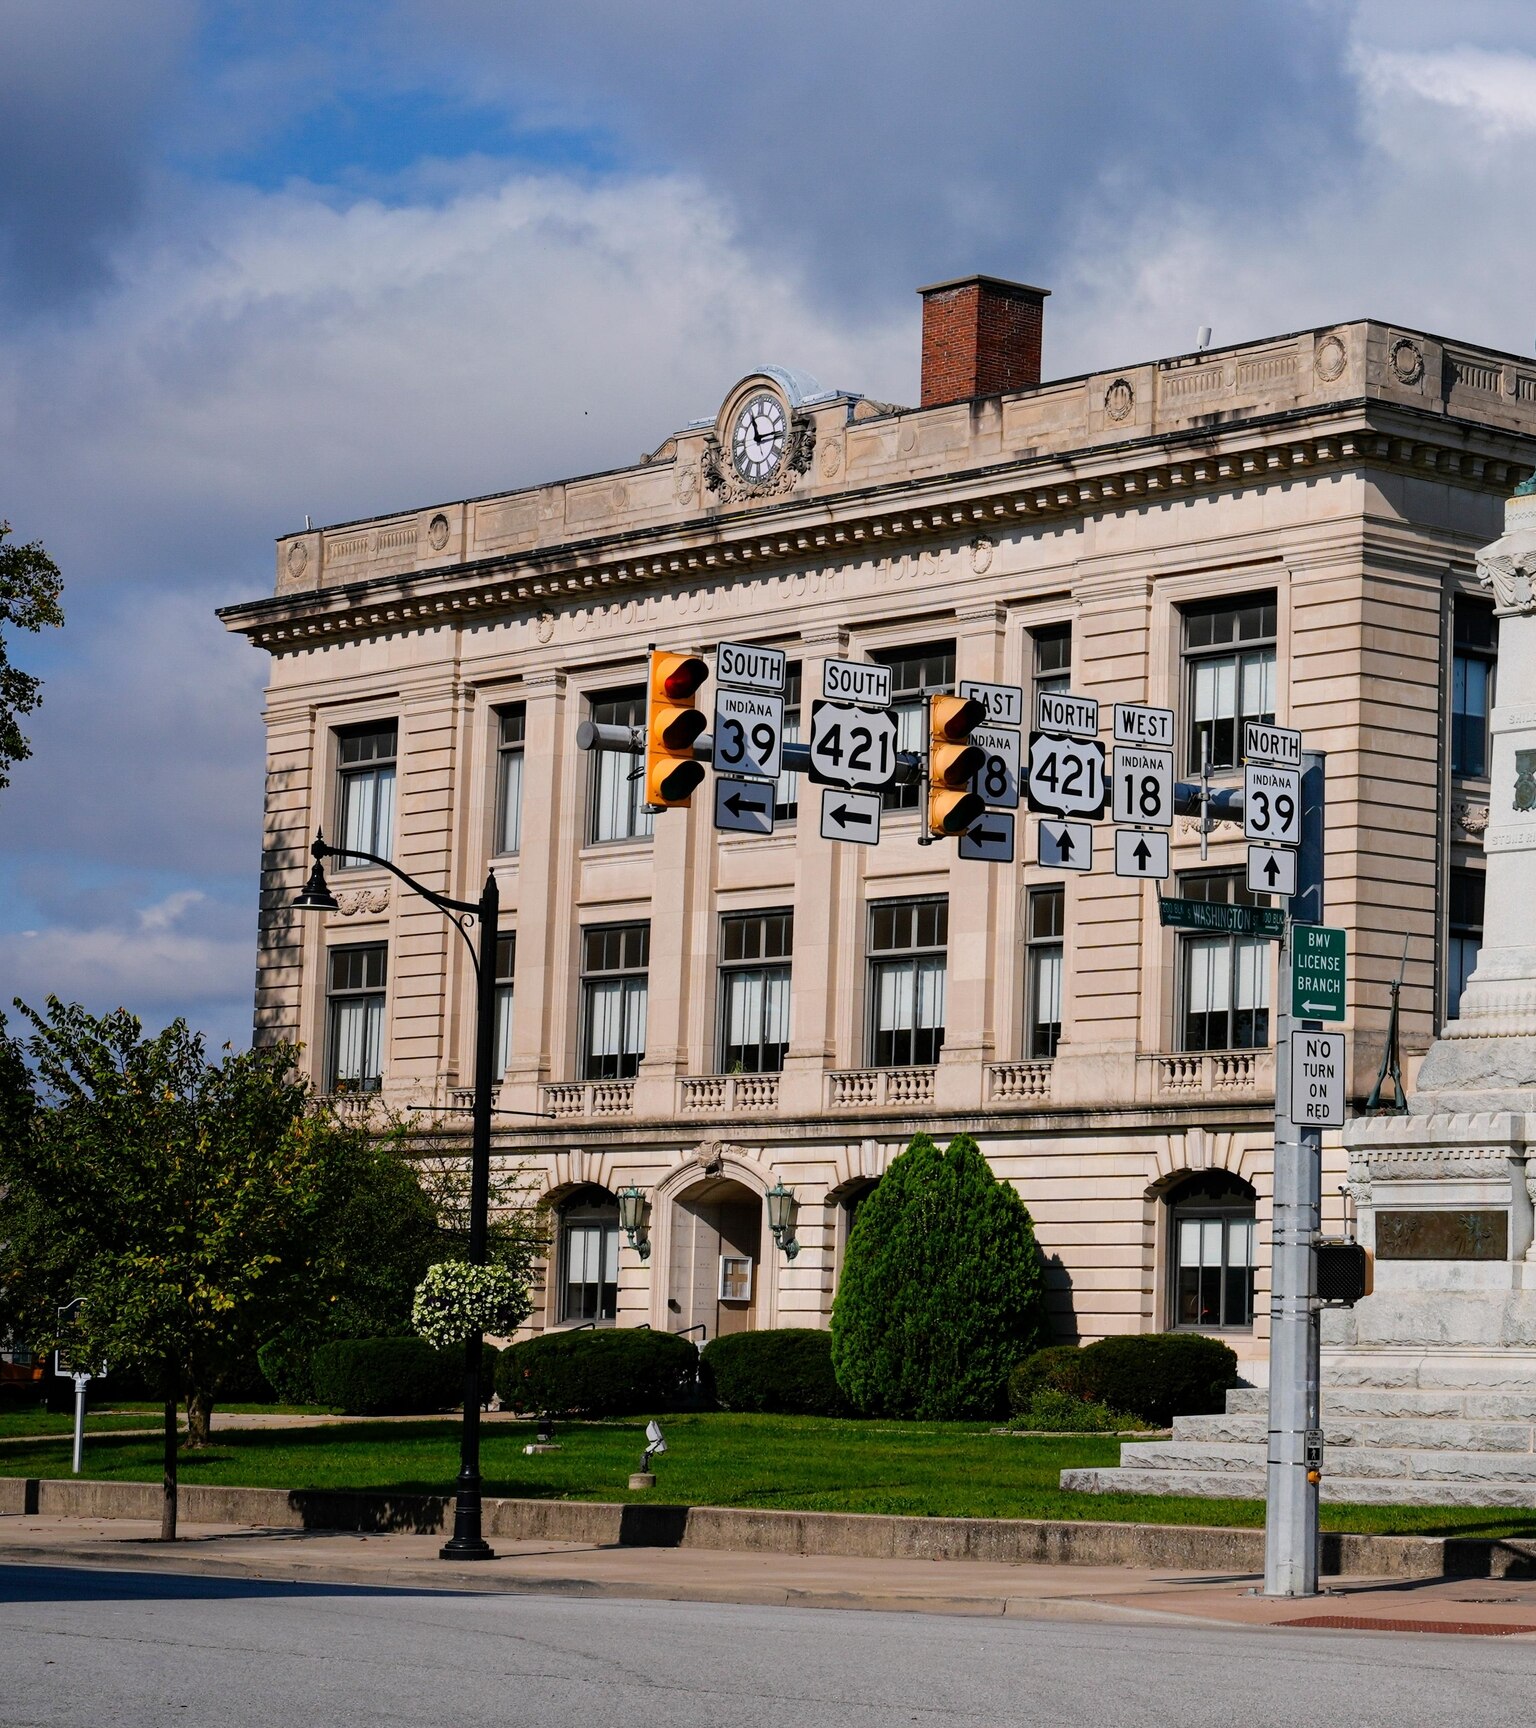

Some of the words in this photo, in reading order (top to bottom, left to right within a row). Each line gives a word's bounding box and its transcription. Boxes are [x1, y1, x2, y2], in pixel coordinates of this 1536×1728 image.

[573, 596, 658, 632] CARROLL
[675, 580, 761, 615] COUNTY
[777, 564, 851, 599] COURT
[873, 549, 951, 585] HOUSE
[721, 649, 781, 681] SOUTH
[827, 665, 887, 697] SOUTH
[725, 699, 773, 717] INDIANA
[1041, 699, 1095, 729] NORTH
[1122, 710, 1168, 738] WEST
[720, 719, 776, 767] 39
[816, 723, 889, 773] 421
[968, 735, 1011, 750] INDIANA
[1249, 728, 1298, 758] NORTH
[1035, 752, 1095, 799] 421
[1121, 755, 1164, 771] INDIANA
[1253, 774, 1292, 789] INDIANA
[1124, 774, 1161, 817] 18
[1250, 791, 1295, 833] 39
[1192, 903, 1251, 930] WASHINGTON
[1308, 932, 1331, 948] BMV
[1298, 954, 1340, 972] LICENSE
[1297, 976, 1341, 994] BRANCH
[1306, 1040, 1331, 1058] NO
[1303, 1063, 1335, 1079] TURN
[1309, 1083, 1327, 1098] ON
[1306, 1103, 1330, 1118] RED
